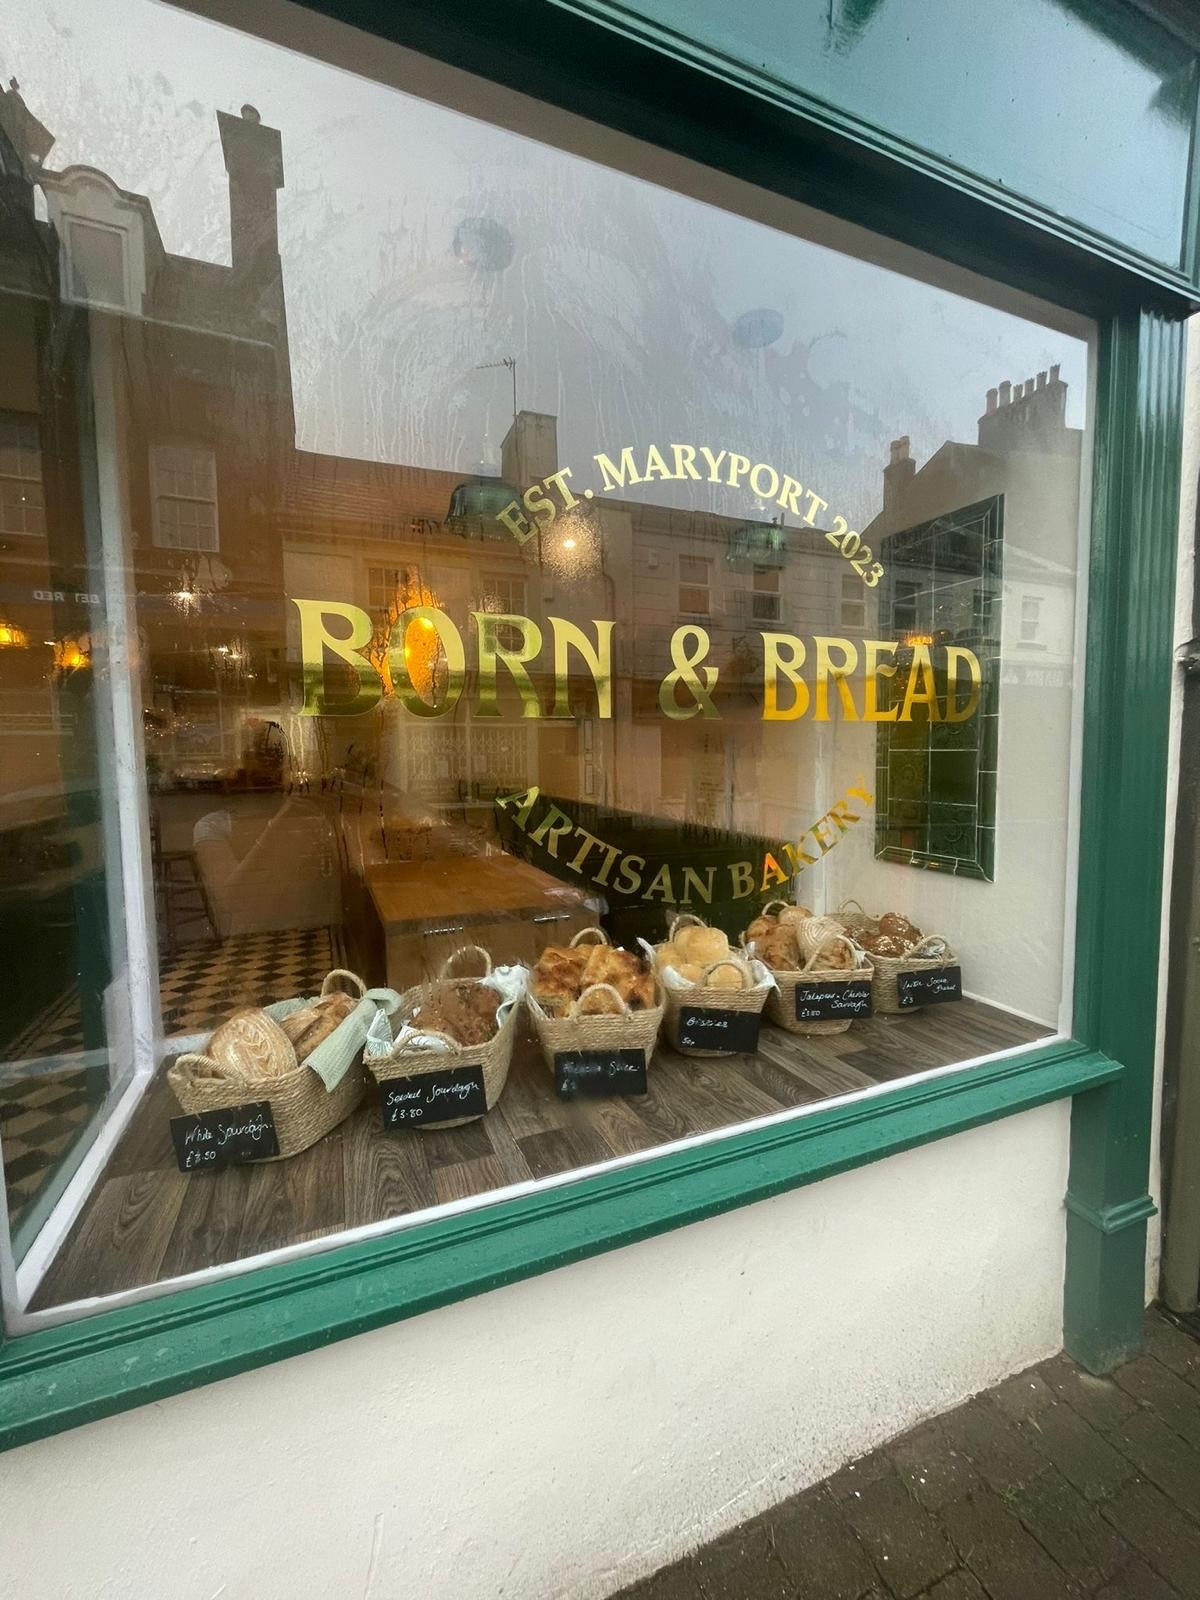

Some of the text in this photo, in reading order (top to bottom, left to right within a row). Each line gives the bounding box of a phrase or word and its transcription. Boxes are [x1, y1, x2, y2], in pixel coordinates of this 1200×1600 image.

[496, 443, 885, 588] EST. MARYPORT 2023
[291, 598, 982, 722] BORN & BREAD
[495, 770, 874, 905] ARTISAN BAKERY
